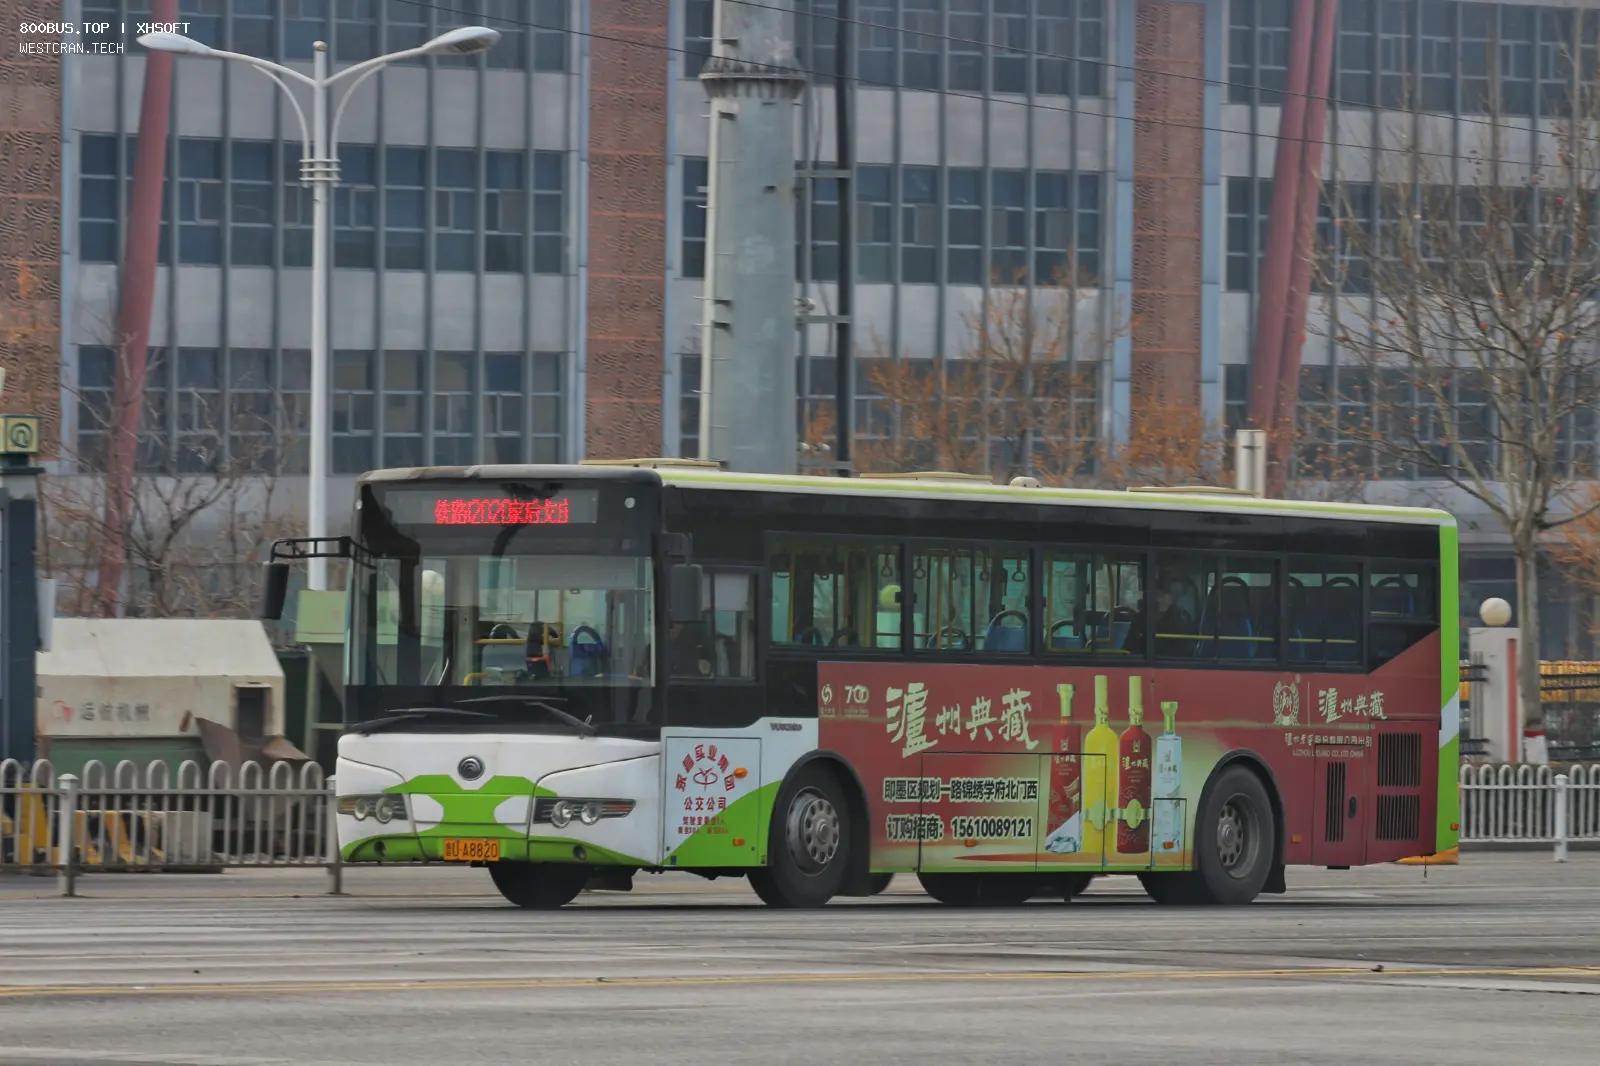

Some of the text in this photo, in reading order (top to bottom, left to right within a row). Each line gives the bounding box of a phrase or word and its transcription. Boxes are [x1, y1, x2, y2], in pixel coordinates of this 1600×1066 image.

[884, 779, 1039, 801] 即墨区规划一路锦绣学府北门西
[683, 796, 727, 811] 公交公司
[951, 817, 1032, 838] 15610089121
